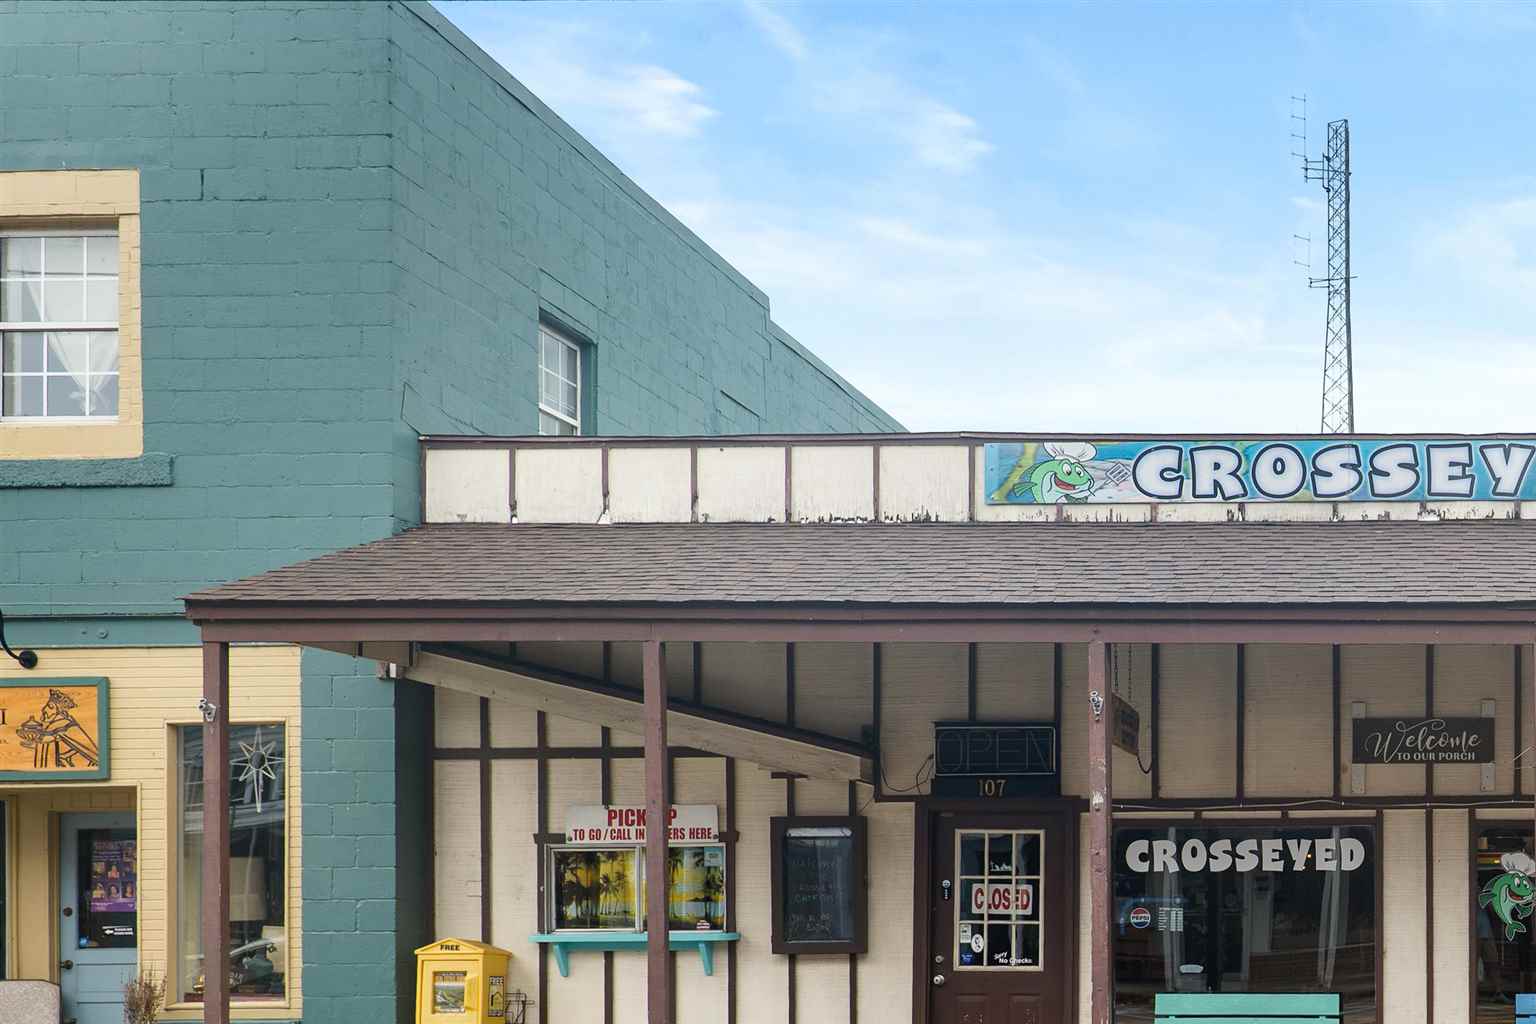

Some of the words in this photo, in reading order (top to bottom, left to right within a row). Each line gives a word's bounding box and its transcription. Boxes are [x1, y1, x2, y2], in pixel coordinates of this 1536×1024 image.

[937, 728, 1052, 771] OPEN
[1364, 719, 1480, 763] Welcome
[1397, 752, 1410, 760] TO
[1413, 752, 1435, 760] OUR
[1438, 752, 1475, 760] PORCH
[979, 779, 1006, 797] 107
[607, 809, 647, 827] PICK
[573, 829, 585, 841] TO
[635, 828, 645, 840] IN
[689, 827, 712, 840] HERE
[1125, 838, 1366, 873] CROSSEYED
